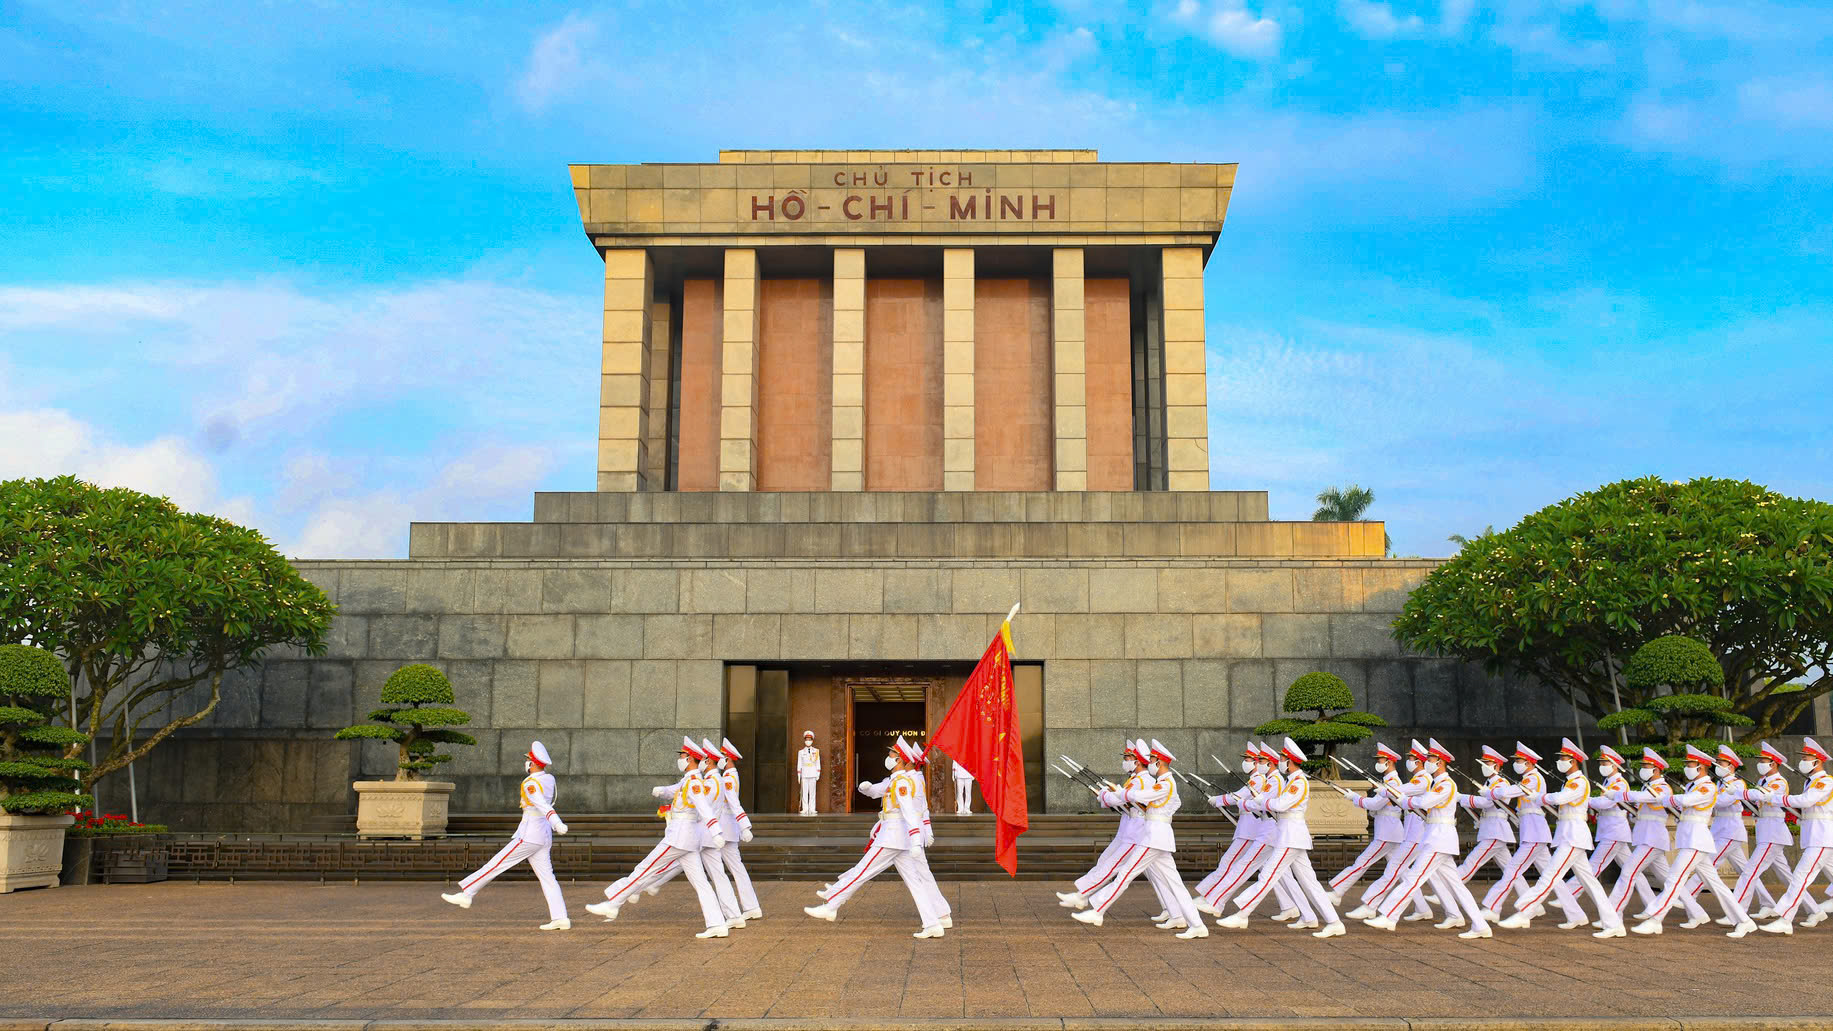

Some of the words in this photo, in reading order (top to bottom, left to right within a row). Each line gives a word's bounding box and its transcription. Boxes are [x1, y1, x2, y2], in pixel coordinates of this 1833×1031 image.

[834, 166, 888, 186] CHỦ
[752, 189, 808, 221] HỒ
[843, 189, 912, 220] CHÍ
[950, 188, 1055, 220] MINH
